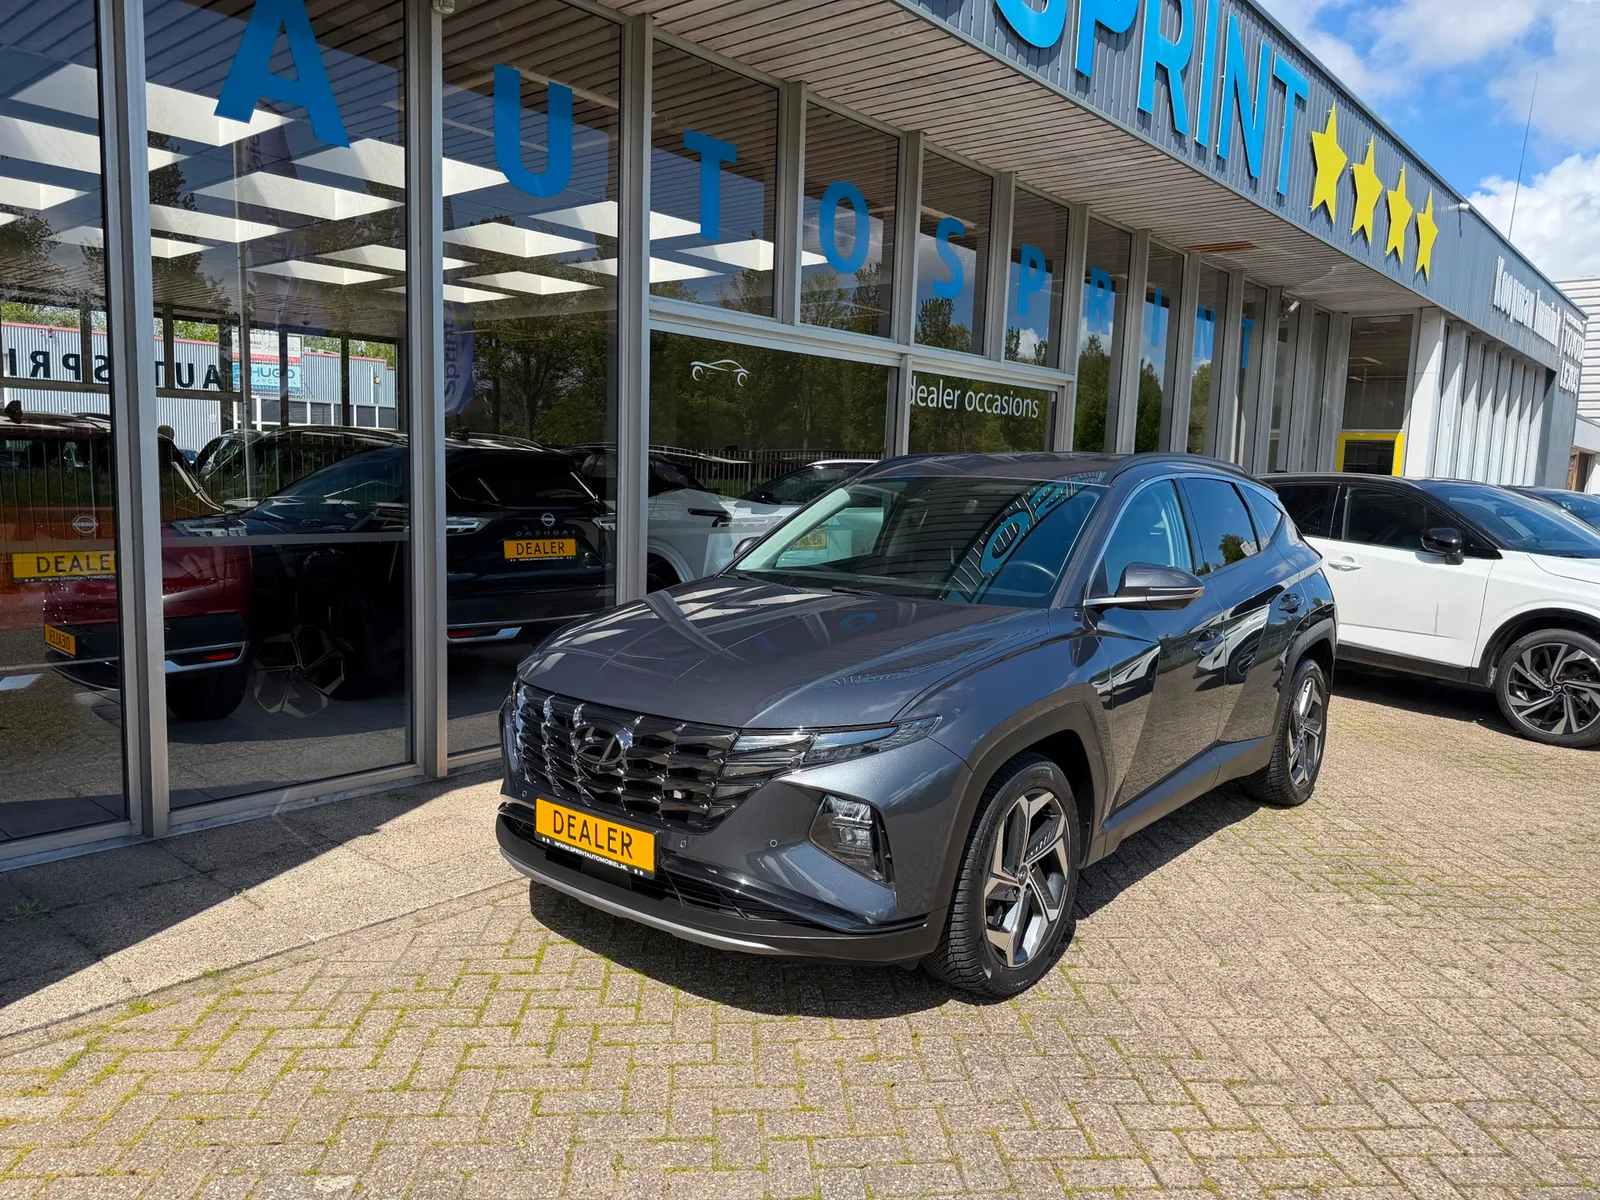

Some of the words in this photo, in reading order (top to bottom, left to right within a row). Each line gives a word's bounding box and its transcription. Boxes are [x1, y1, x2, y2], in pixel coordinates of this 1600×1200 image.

[994, 0, 1309, 196] RINT
[909, 375, 961, 409] dealer
[964, 390, 1039, 419] occasions
[37, 553, 117, 573] DEALE
[516, 541, 566, 555] DEALER
[553, 809, 633, 860] DEALER
